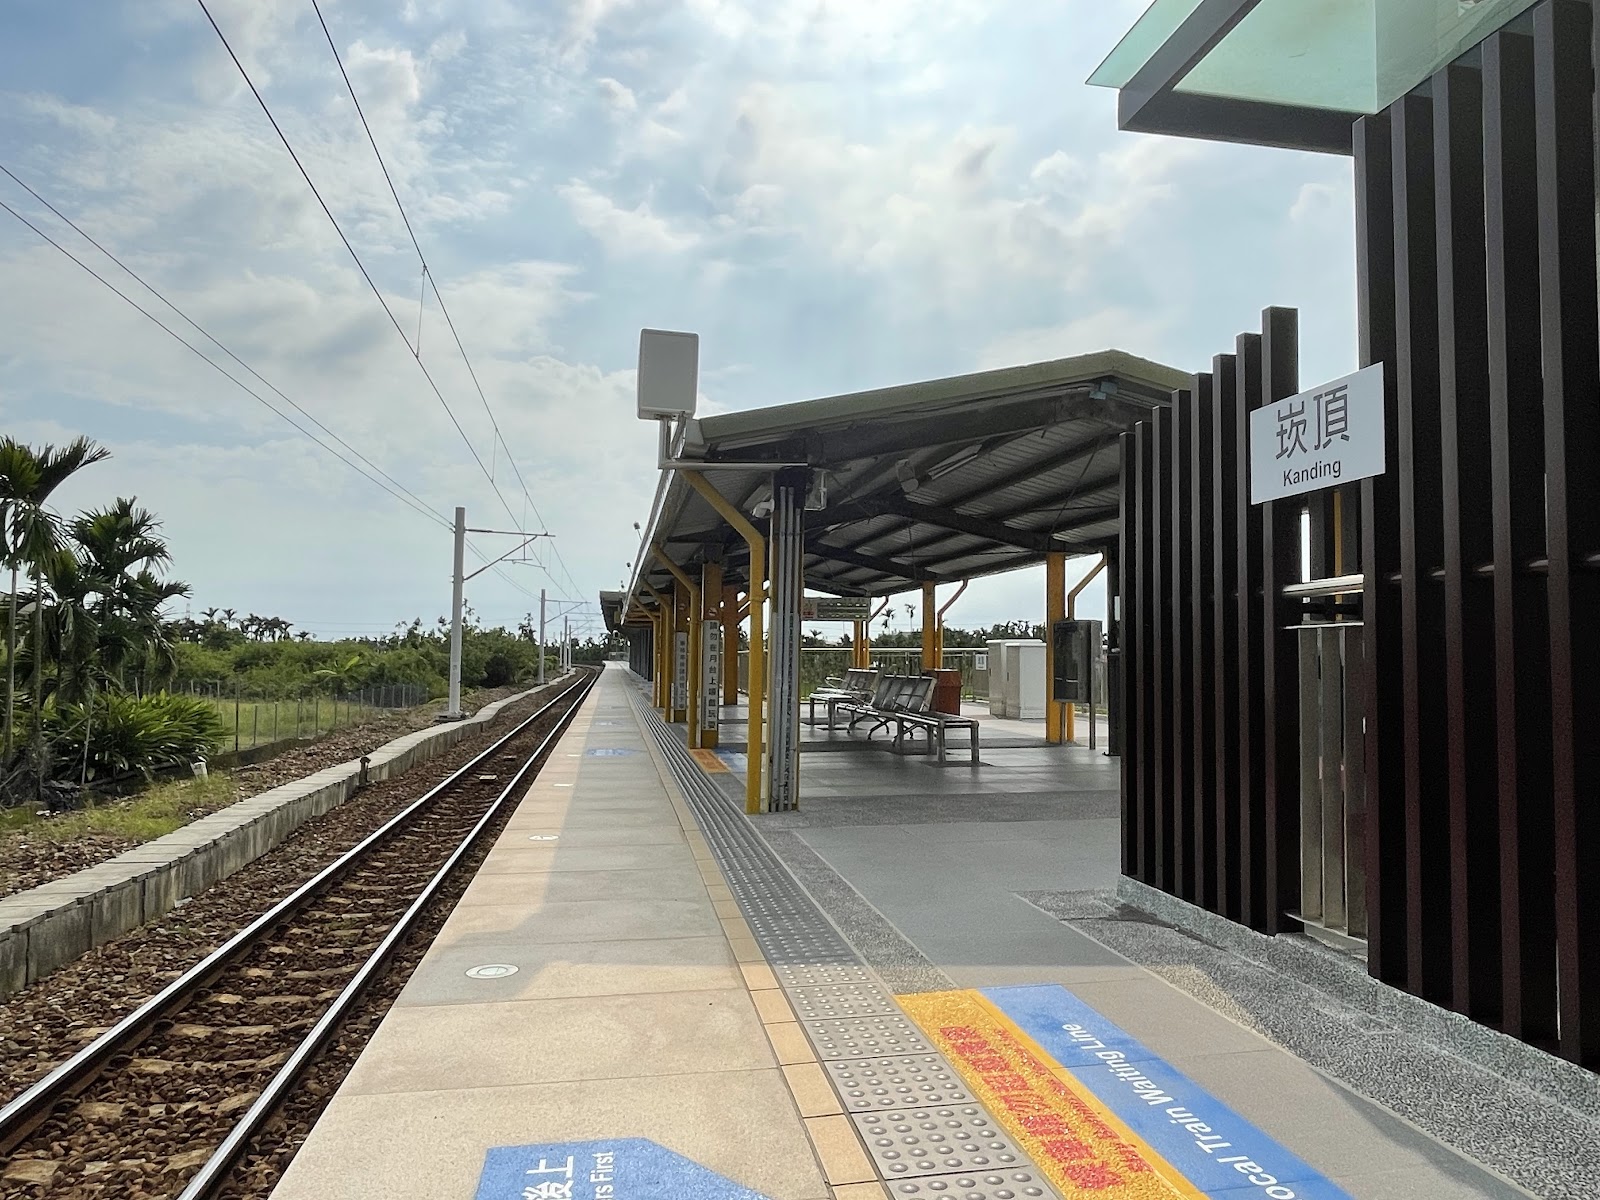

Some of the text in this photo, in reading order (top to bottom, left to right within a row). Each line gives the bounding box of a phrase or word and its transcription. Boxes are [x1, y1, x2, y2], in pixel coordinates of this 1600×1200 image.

[1275, 384, 1350, 460] 崁頂
[1283, 460, 1341, 487] Kanding
[1062, 1023, 1106, 1051] Line
[1095, 1050, 1174, 1106] Waiting
[1165, 1106, 1232, 1154] Train
[589, 1151, 614, 1183] First
[1216, 1155, 1303, 1200] ocal
